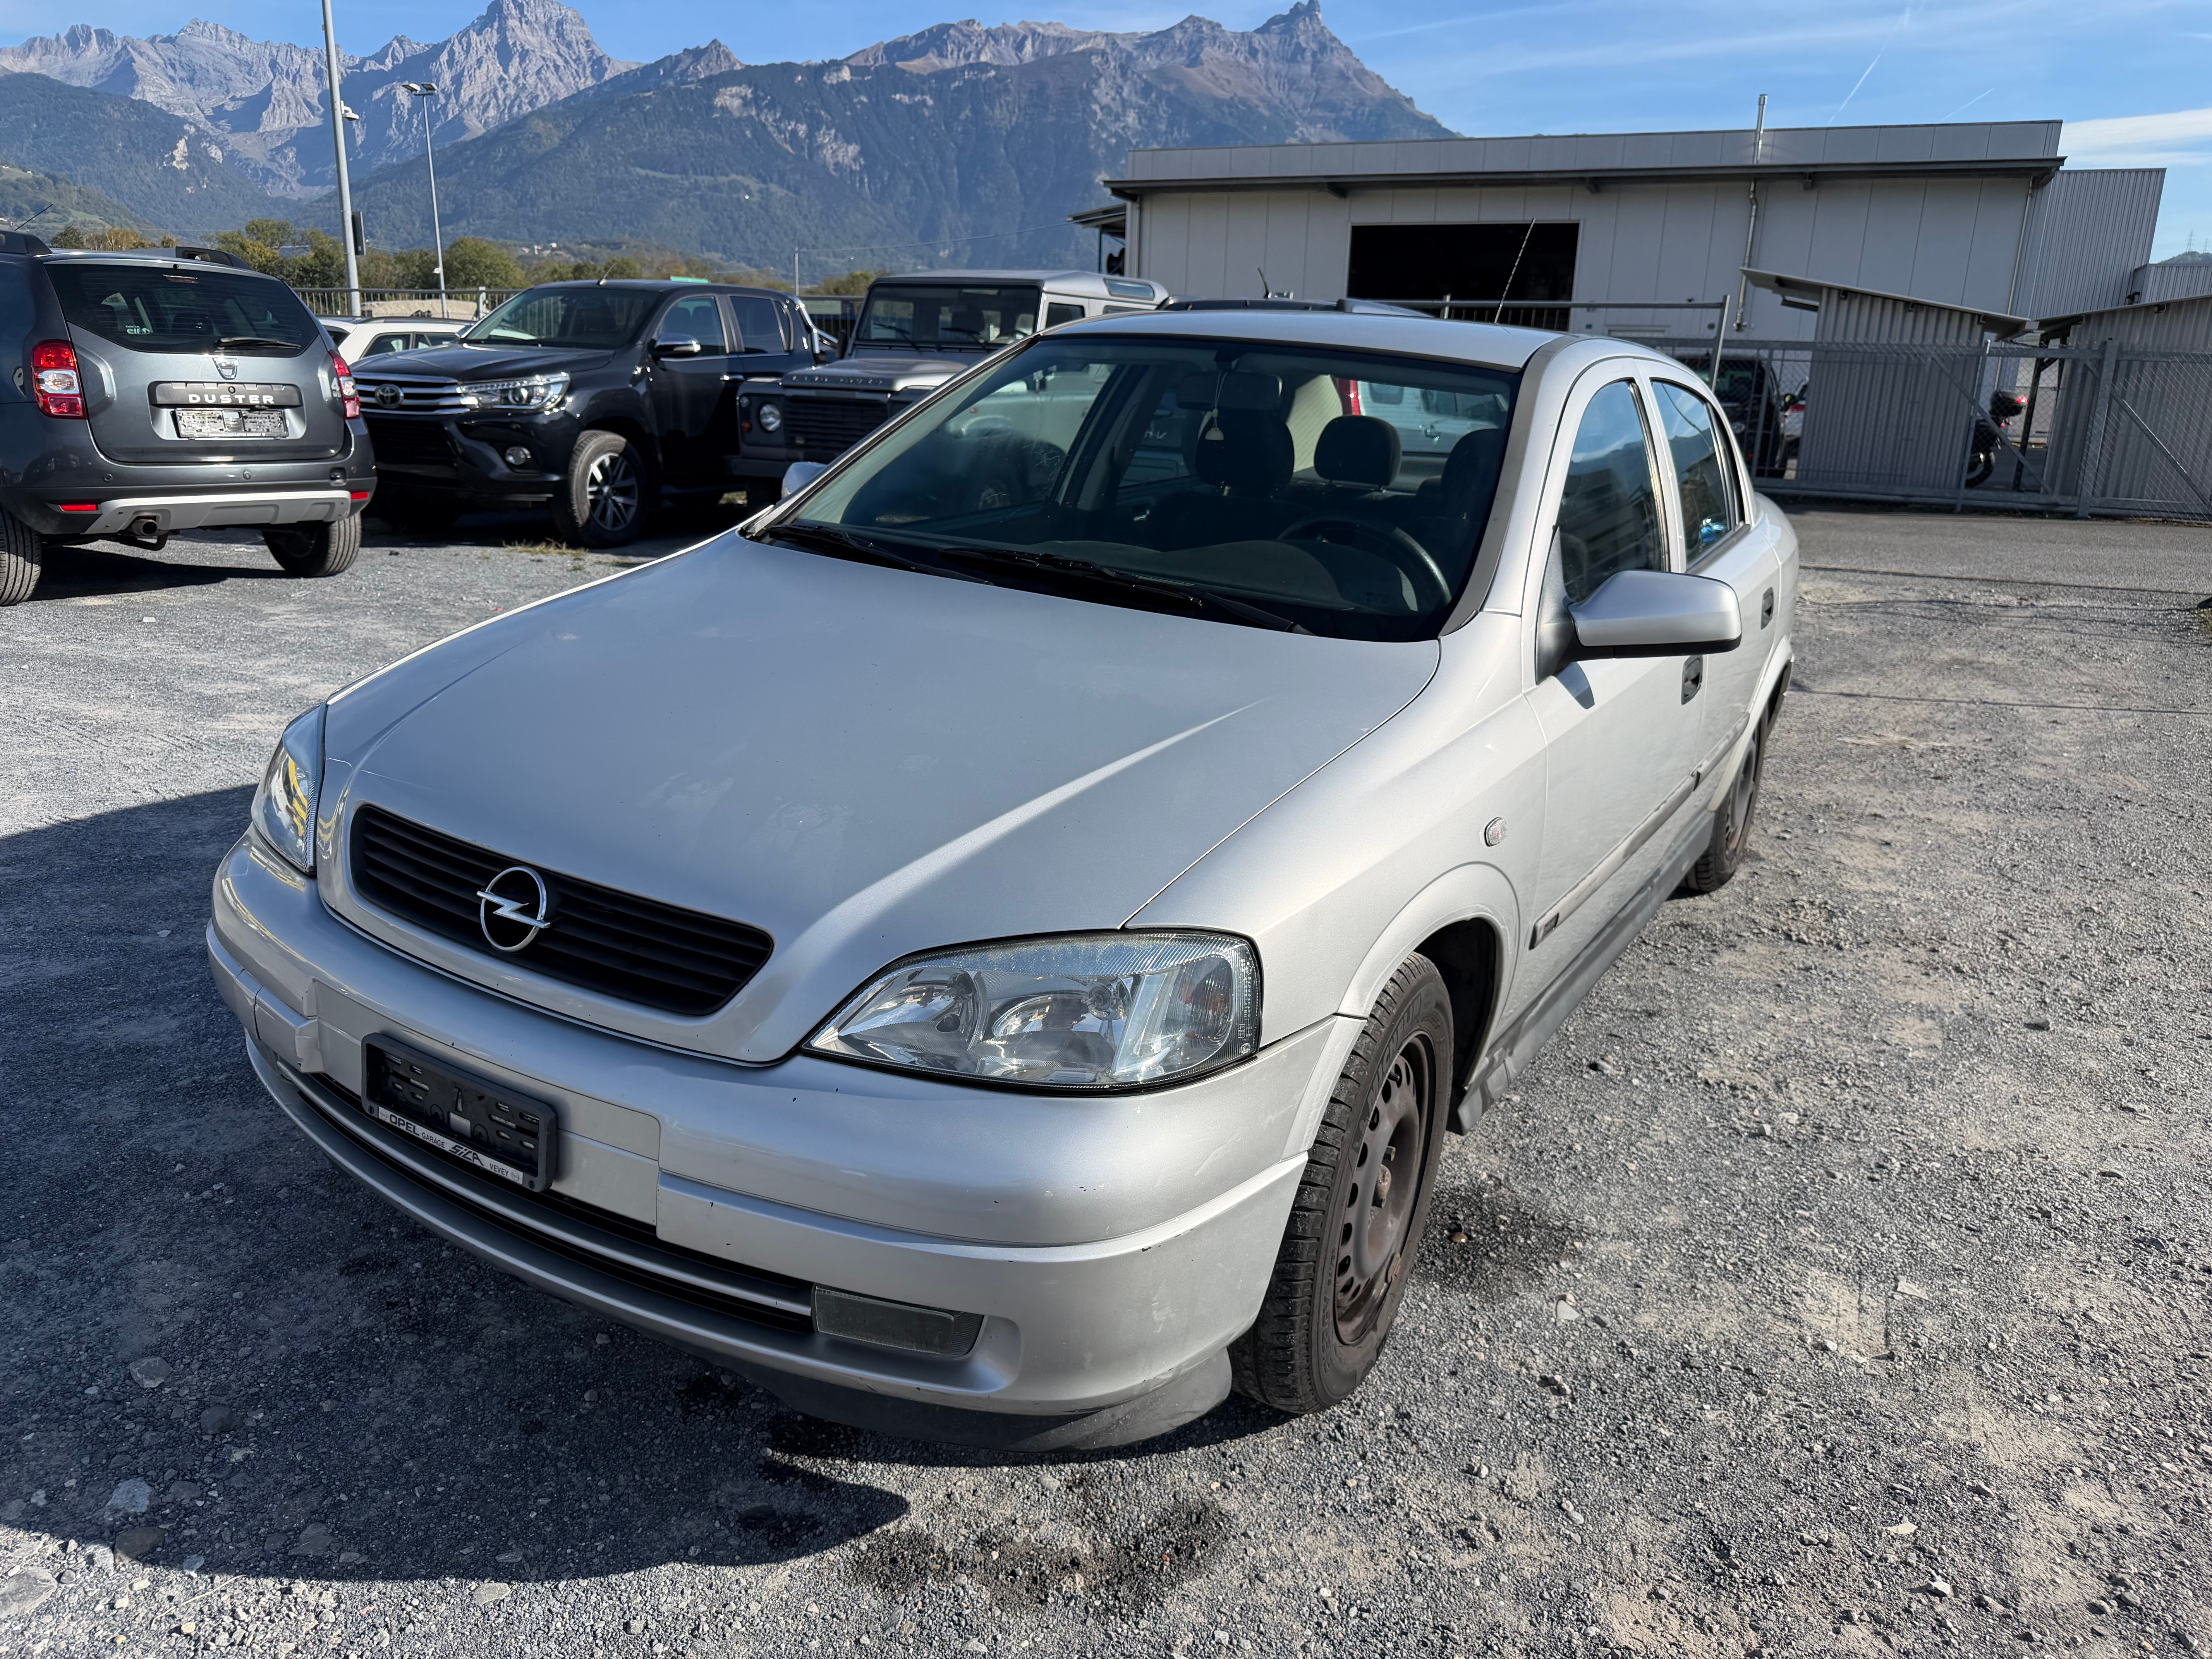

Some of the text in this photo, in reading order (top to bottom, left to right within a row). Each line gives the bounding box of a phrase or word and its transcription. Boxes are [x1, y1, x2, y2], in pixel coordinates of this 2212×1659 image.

[188, 394, 275, 404] DUSTER
[331, 377, 340, 391] 4
[1367, 992, 1422, 1110] MICHELIN
[389, 1114, 420, 1137] OPEL
[421, 1132, 445, 1149] GARAGE
[489, 1163, 509, 1176] VEVEY
